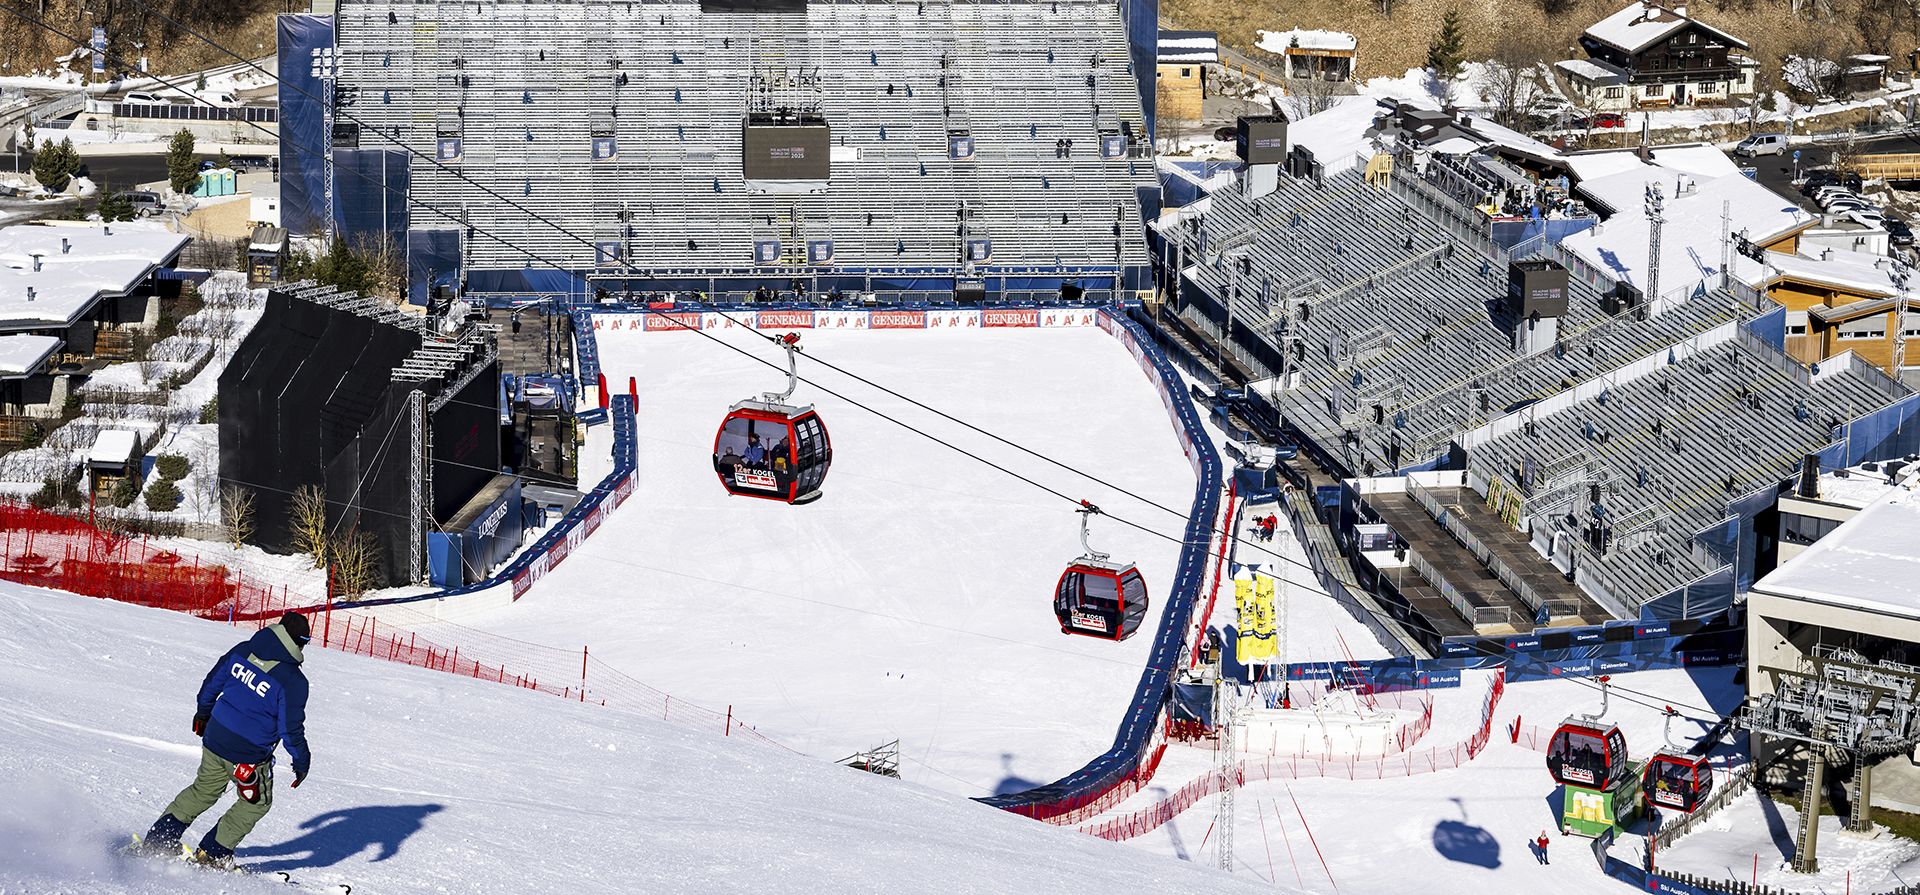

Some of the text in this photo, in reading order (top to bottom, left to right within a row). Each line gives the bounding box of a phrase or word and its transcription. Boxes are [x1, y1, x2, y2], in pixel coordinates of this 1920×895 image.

[646, 313, 699, 329] GENERALI
[760, 312, 812, 328] GENERALI
[872, 312, 924, 327] GENERALI
[984, 311, 1037, 326] GENERALI
[734, 464, 751, 474] 12er
[753, 469, 774, 478] KOGEL
[478, 501, 508, 540] LONGINES
[1071, 609, 1086, 618] 12er
[231, 662, 271, 698] CHILE
[1440, 675, 1459, 683] Austria
[1561, 763, 1575, 772] 12er
[1660, 884, 1690, 895] Ski Austria
